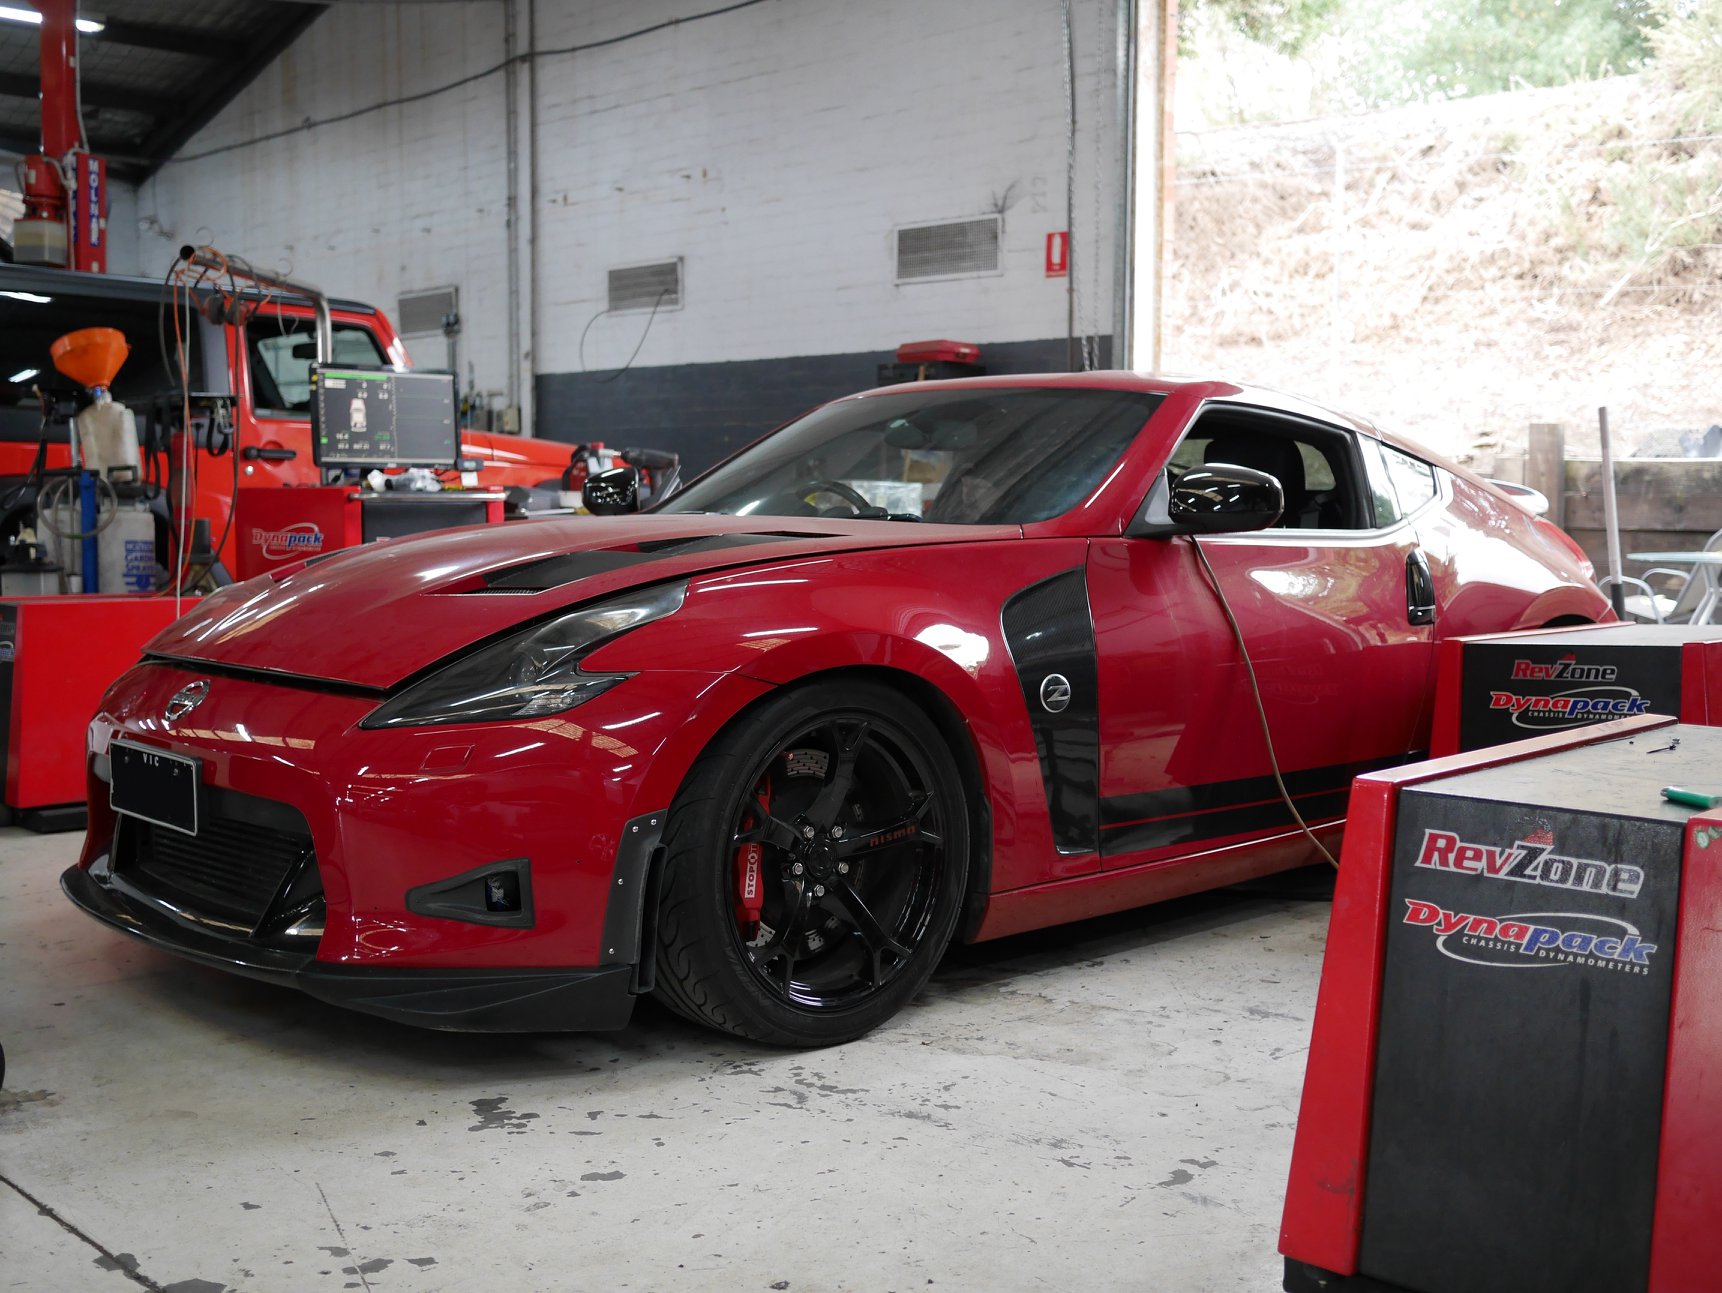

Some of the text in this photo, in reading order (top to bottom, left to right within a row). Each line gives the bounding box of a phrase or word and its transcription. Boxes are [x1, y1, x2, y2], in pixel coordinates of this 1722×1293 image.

[1511, 660, 1617, 681] RevZone
[1490, 691, 1651, 718] Dynapack
[143, 753, 159, 767] VIC
[1415, 828, 1645, 898] RevZone
[1403, 899, 1658, 965] Dynapack
[1463, 936, 1649, 975] CHASSIS DYNAMOMETERS
